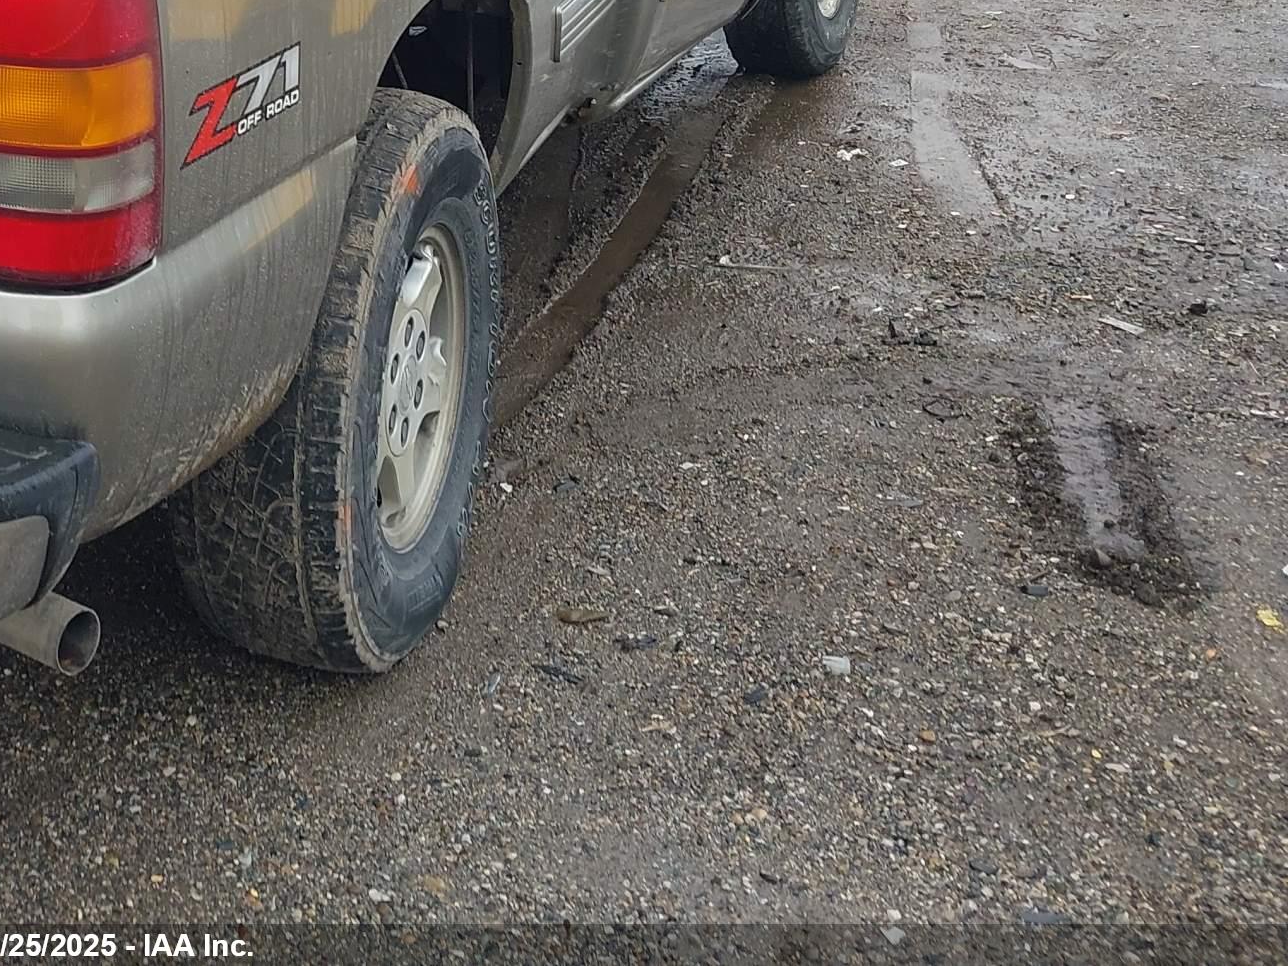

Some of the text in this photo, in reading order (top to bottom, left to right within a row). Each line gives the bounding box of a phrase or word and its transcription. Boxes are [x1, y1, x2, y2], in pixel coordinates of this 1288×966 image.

[180, 41, 301, 170] Z71
[236, 90, 301, 136] OFF ROAD
